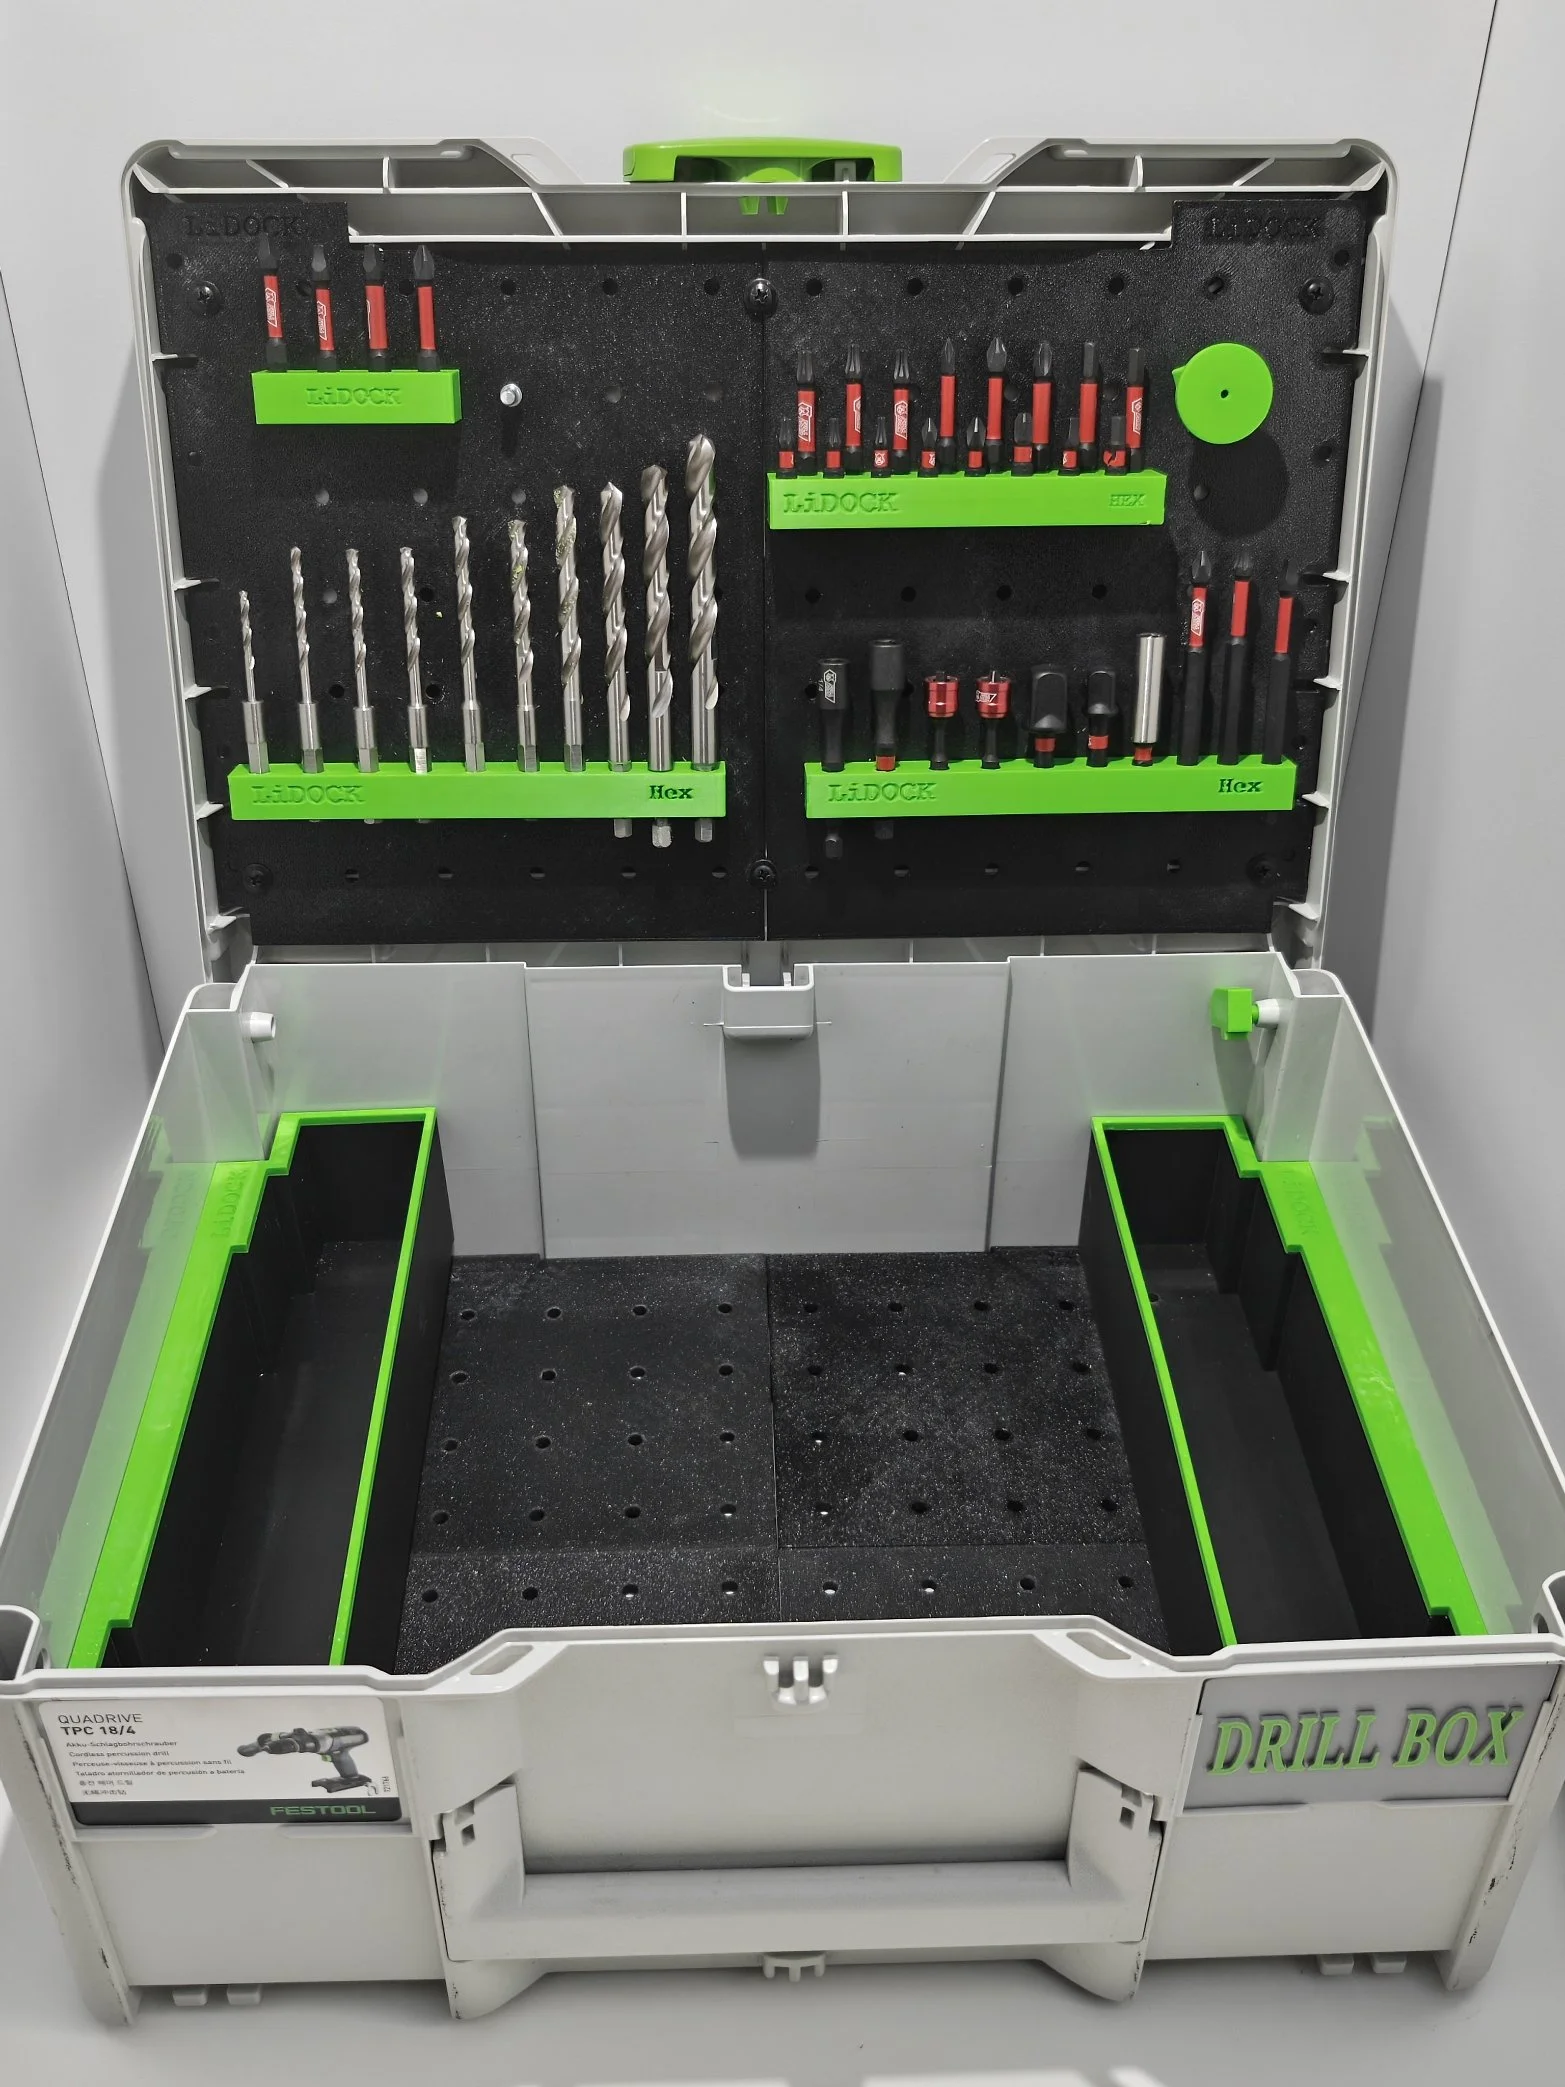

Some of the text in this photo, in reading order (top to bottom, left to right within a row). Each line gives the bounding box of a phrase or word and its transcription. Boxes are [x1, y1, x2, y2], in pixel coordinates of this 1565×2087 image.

[305, 386, 402, 406] LiDOCK
[782, 491, 899, 514] LiDOCK
[1109, 493, 1147, 508] HEX
[250, 784, 366, 805] LiDOCK
[648, 783, 695, 801] Hex
[827, 781, 937, 802] LiDOCK
[1218, 777, 1263, 795] Hex
[58, 1713, 143, 1724] QUADRIVE
[60, 1725, 136, 1736] TPC 18/4
[1206, 1705, 1526, 1775] DRILL BOX
[269, 1804, 377, 1816] FESTOOL
